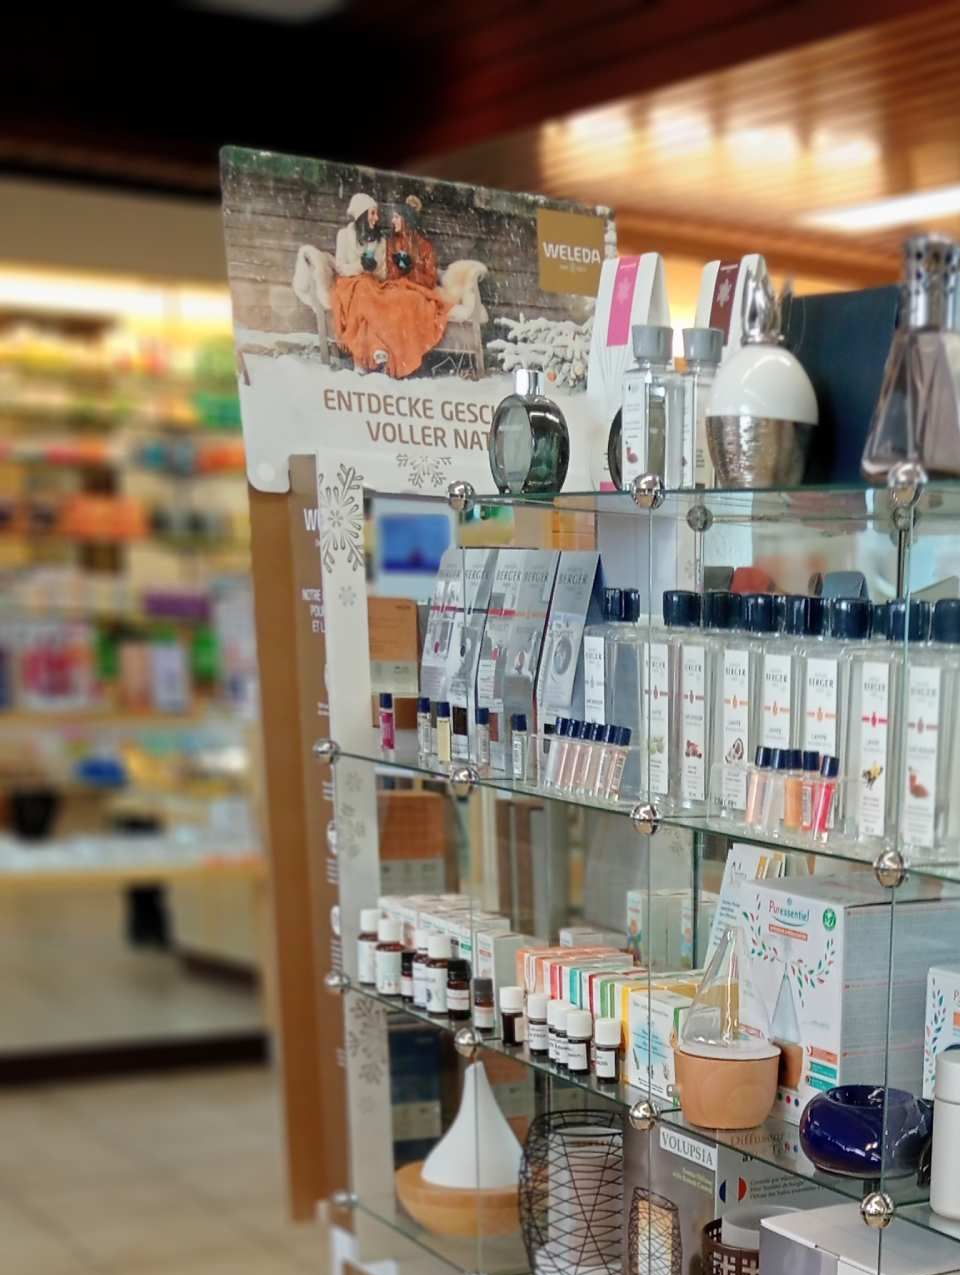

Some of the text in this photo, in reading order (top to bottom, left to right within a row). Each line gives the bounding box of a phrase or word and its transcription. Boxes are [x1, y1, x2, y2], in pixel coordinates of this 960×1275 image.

[543, 242, 600, 265] WELEDA
[323, 389, 434, 419] ENTDECKE
[366, 420, 447, 448] VOLLER
[661, 1130, 714, 1167] VOLUPSIA
